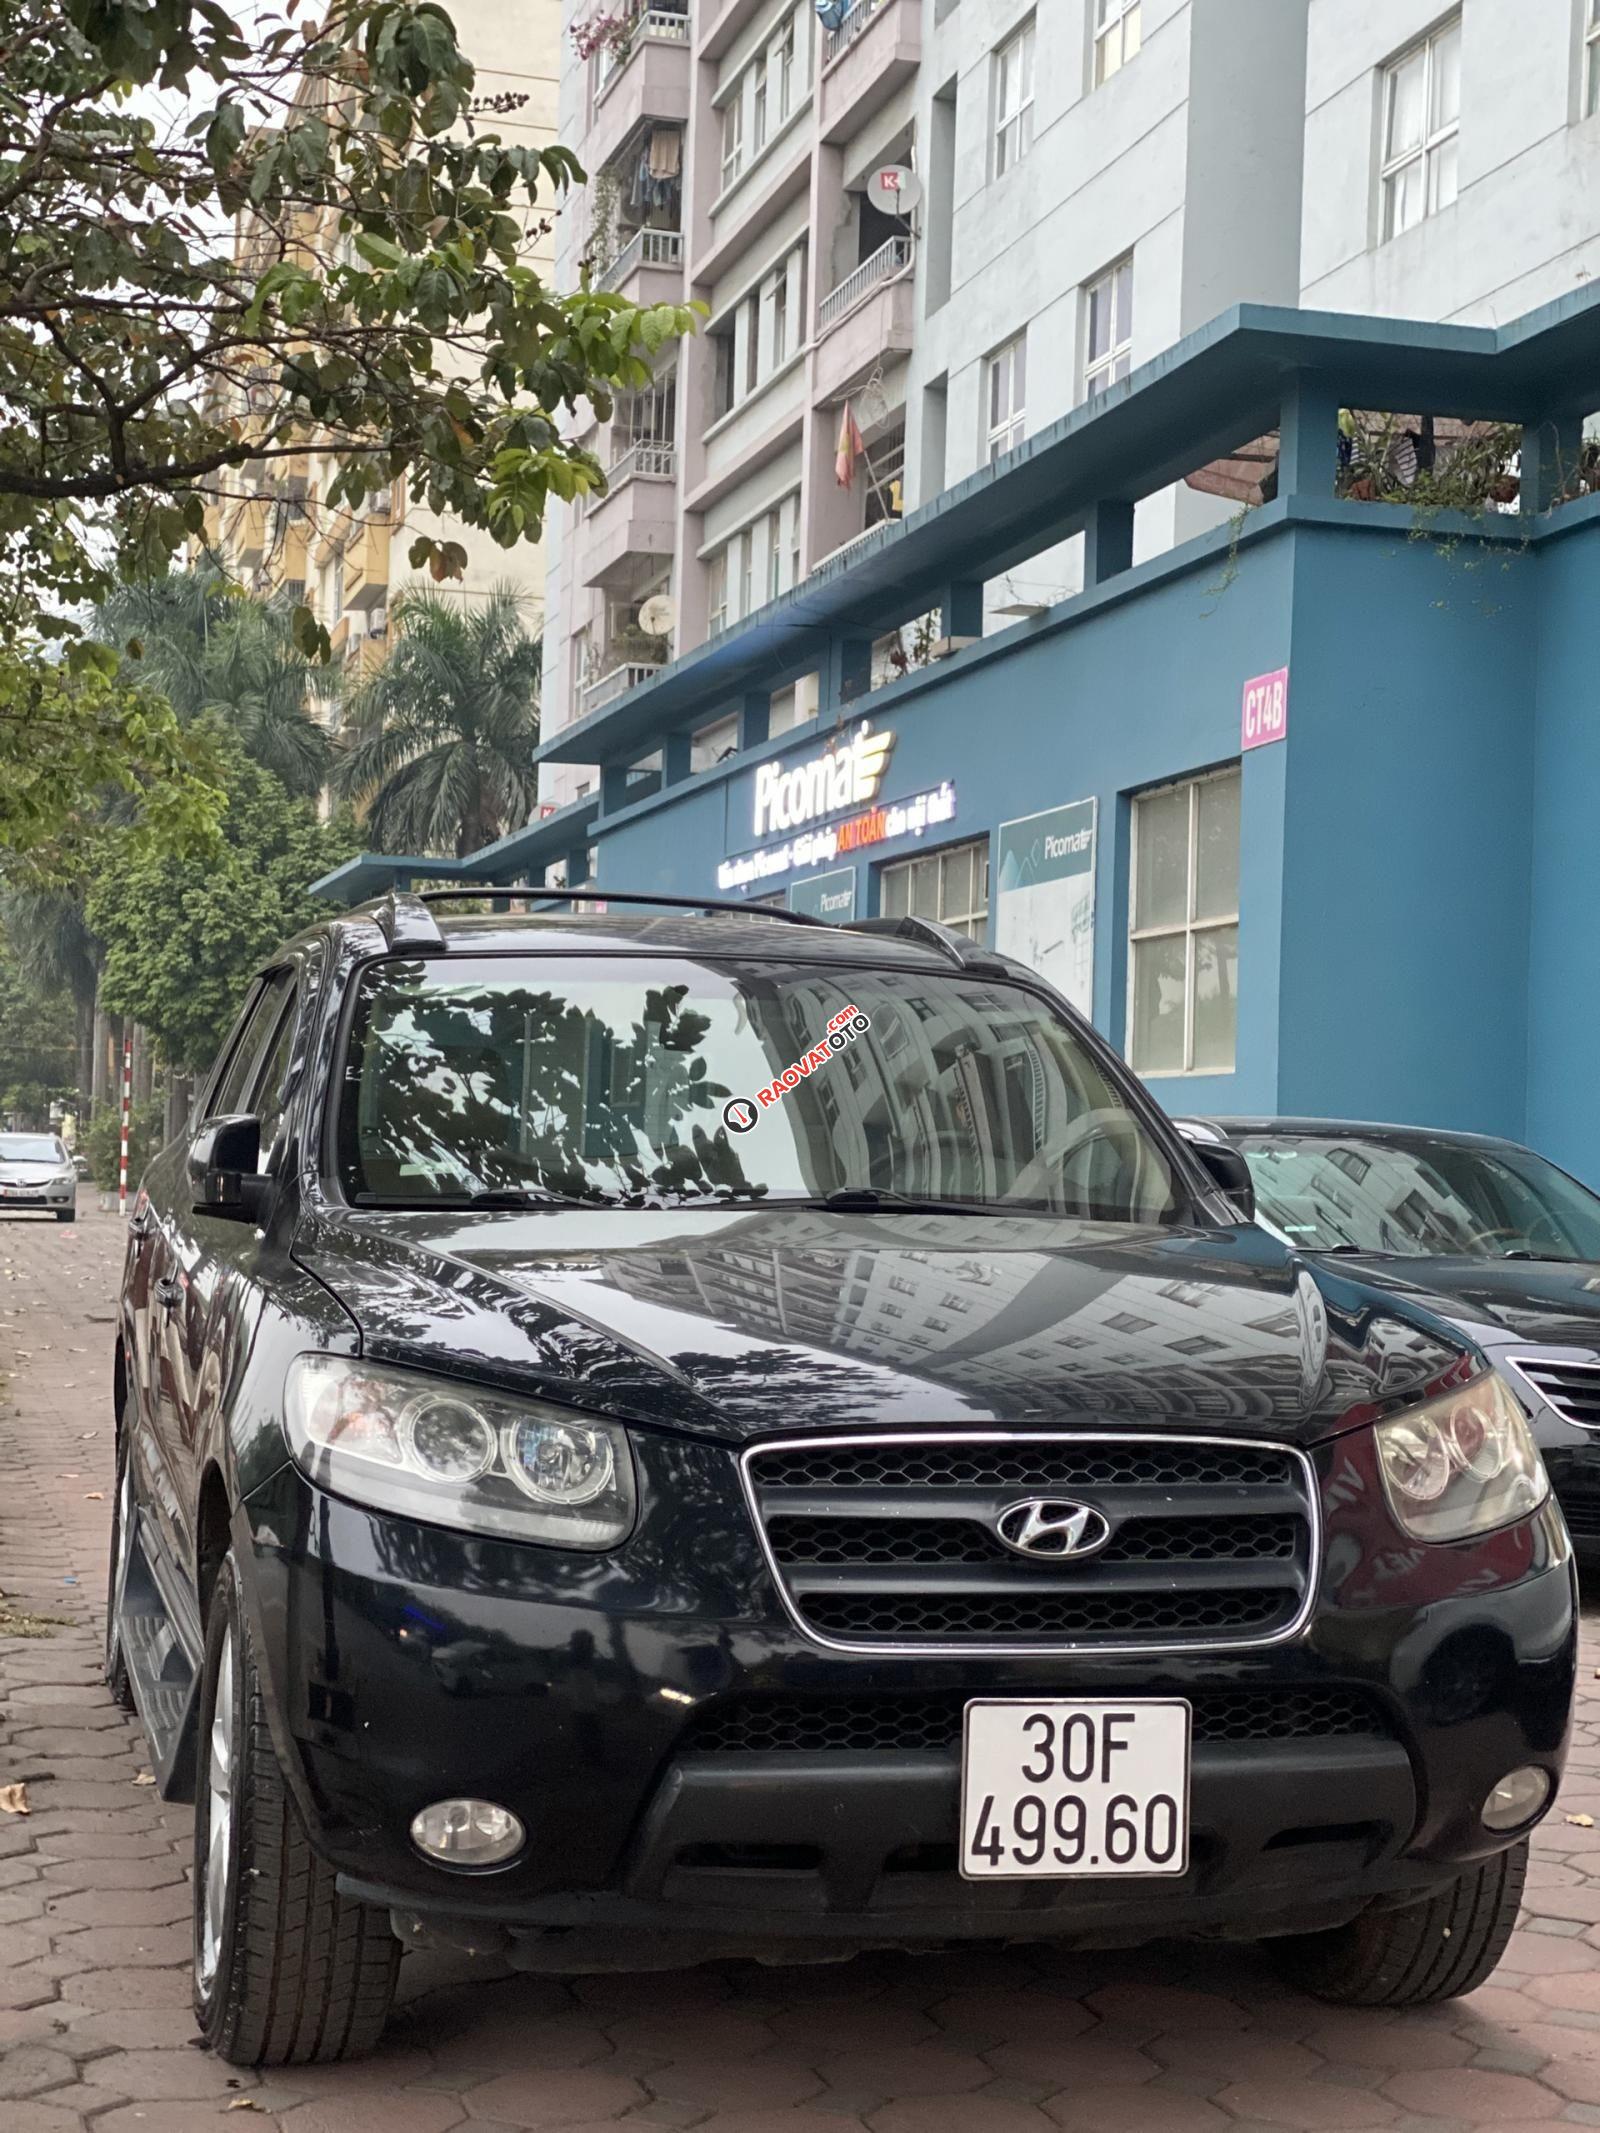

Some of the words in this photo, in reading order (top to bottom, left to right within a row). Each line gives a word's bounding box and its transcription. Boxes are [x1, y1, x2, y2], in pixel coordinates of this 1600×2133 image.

[1246, 681, 1283, 738] CT4B
[754, 719, 892, 837] Picomat
[1044, 828, 1092, 860] Picomat
[1022, 1713, 1136, 1783] 30F
[971, 1793, 1178, 1867] 499.60
